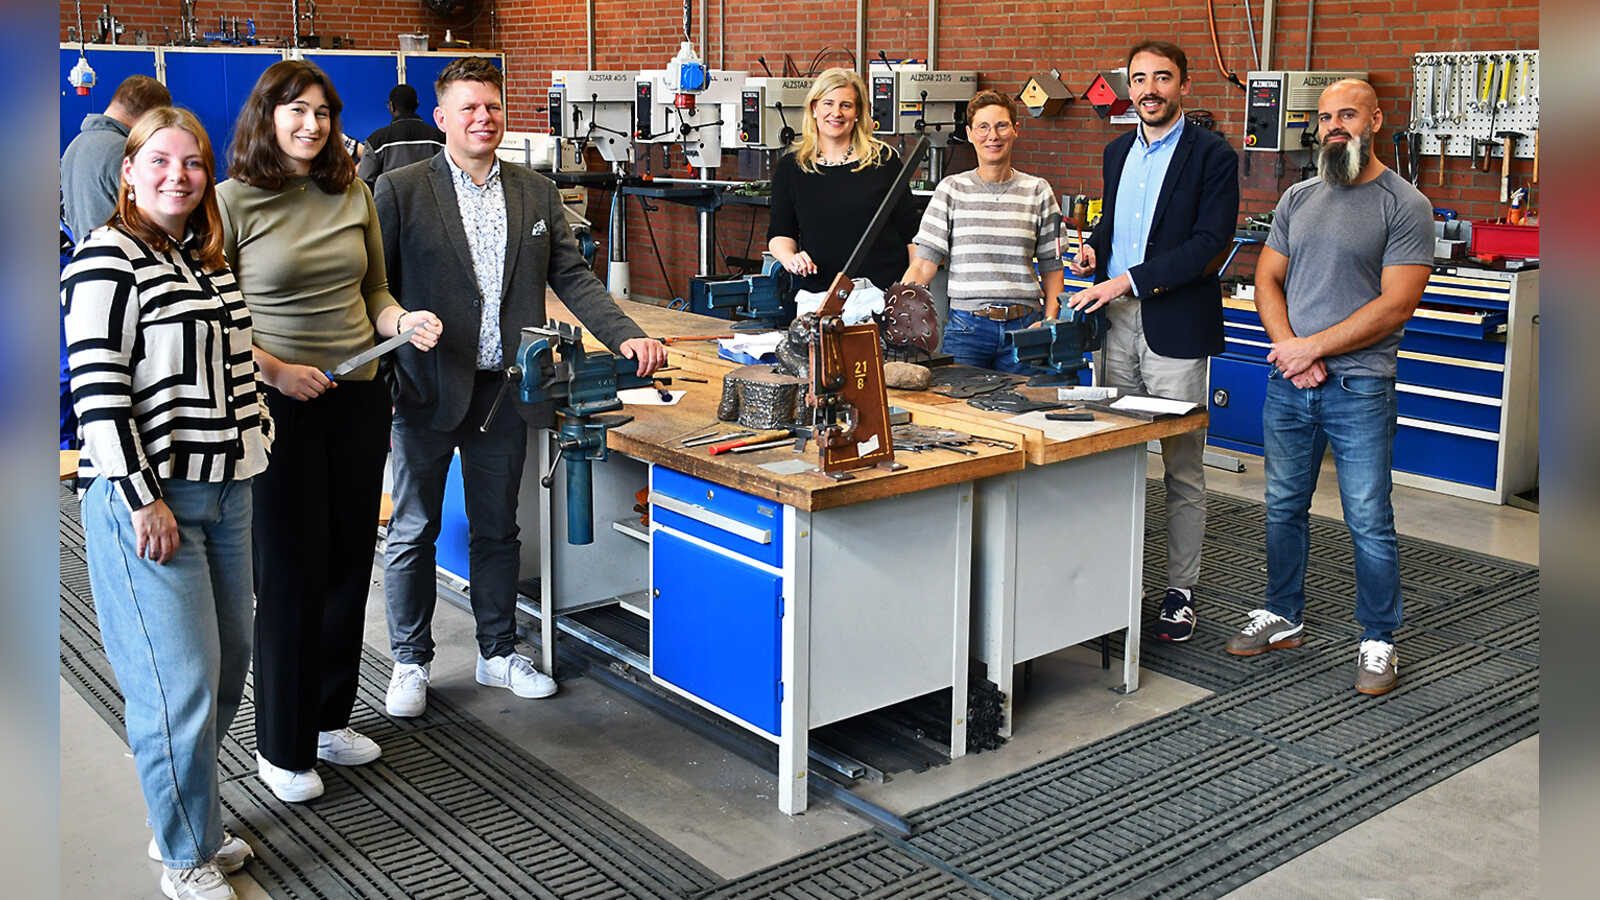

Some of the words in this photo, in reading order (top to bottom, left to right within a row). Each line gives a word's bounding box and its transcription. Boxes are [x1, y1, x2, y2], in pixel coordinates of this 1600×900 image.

[782, 81, 808, 89] ALZSTAR
[855, 360, 867, 374] 21
[857, 378, 864, 390] 8
